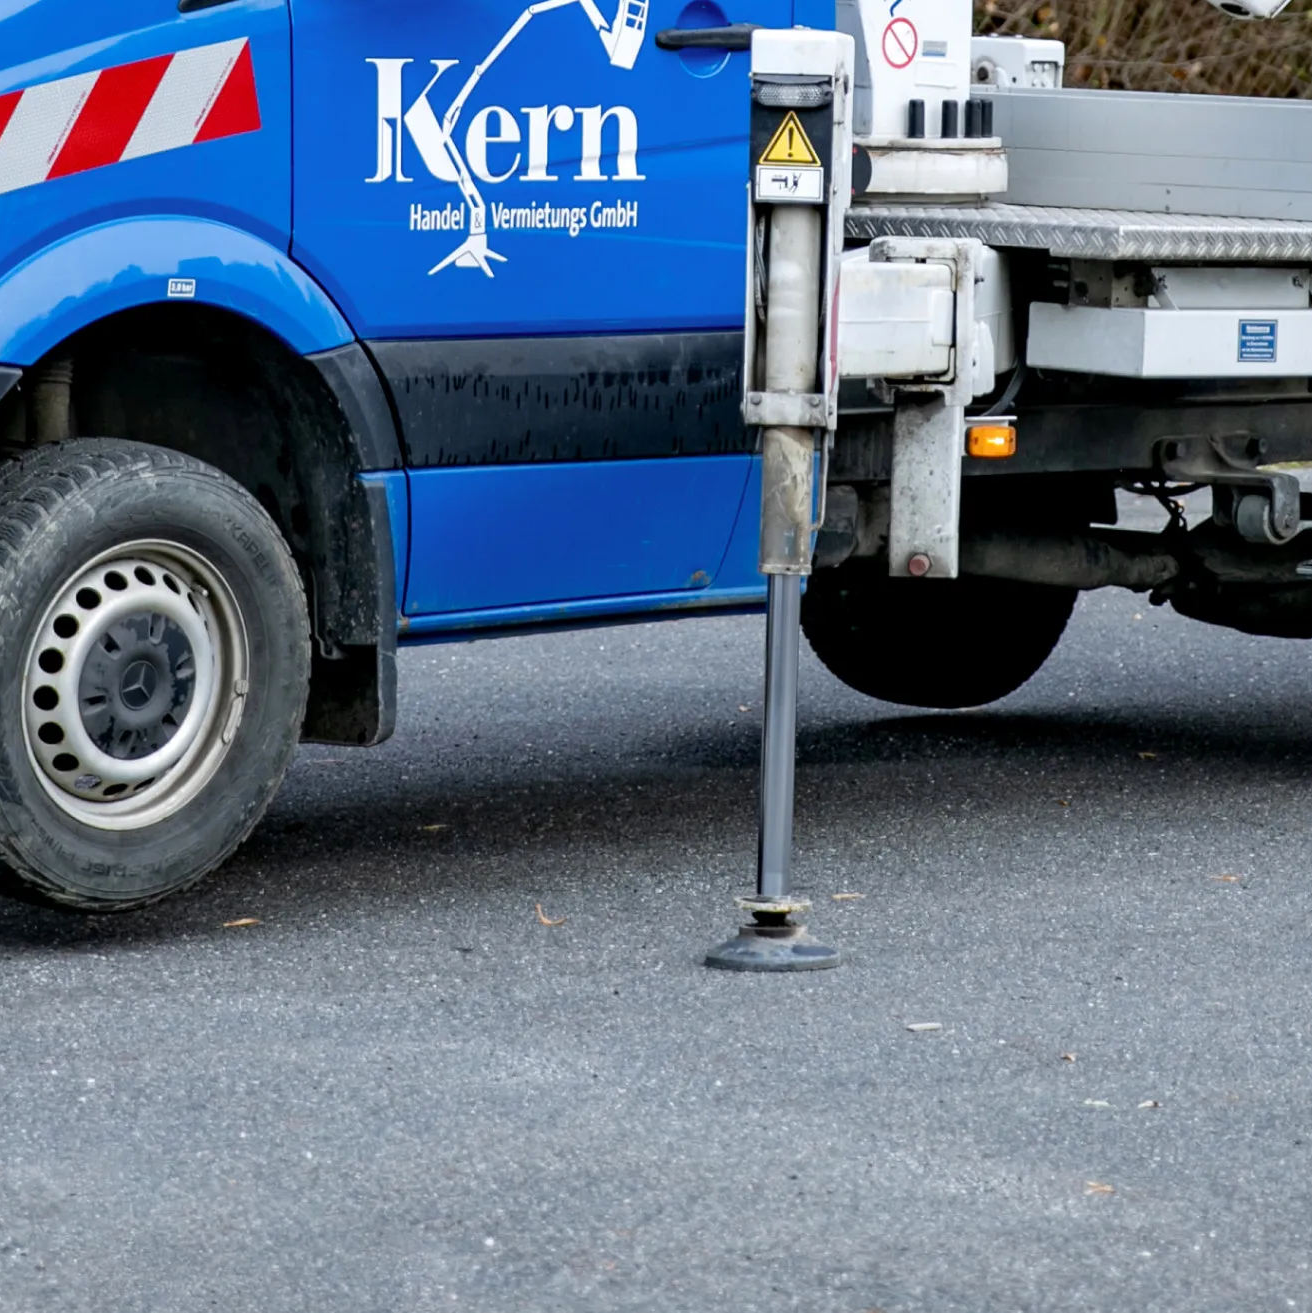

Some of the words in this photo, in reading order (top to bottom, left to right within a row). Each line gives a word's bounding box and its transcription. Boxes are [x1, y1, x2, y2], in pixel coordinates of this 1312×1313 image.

[364, 58, 646, 184] Kern
[409, 202, 465, 231] Handel
[491, 201, 587, 237] Vermietungs
[590, 199, 638, 228] GmbH
